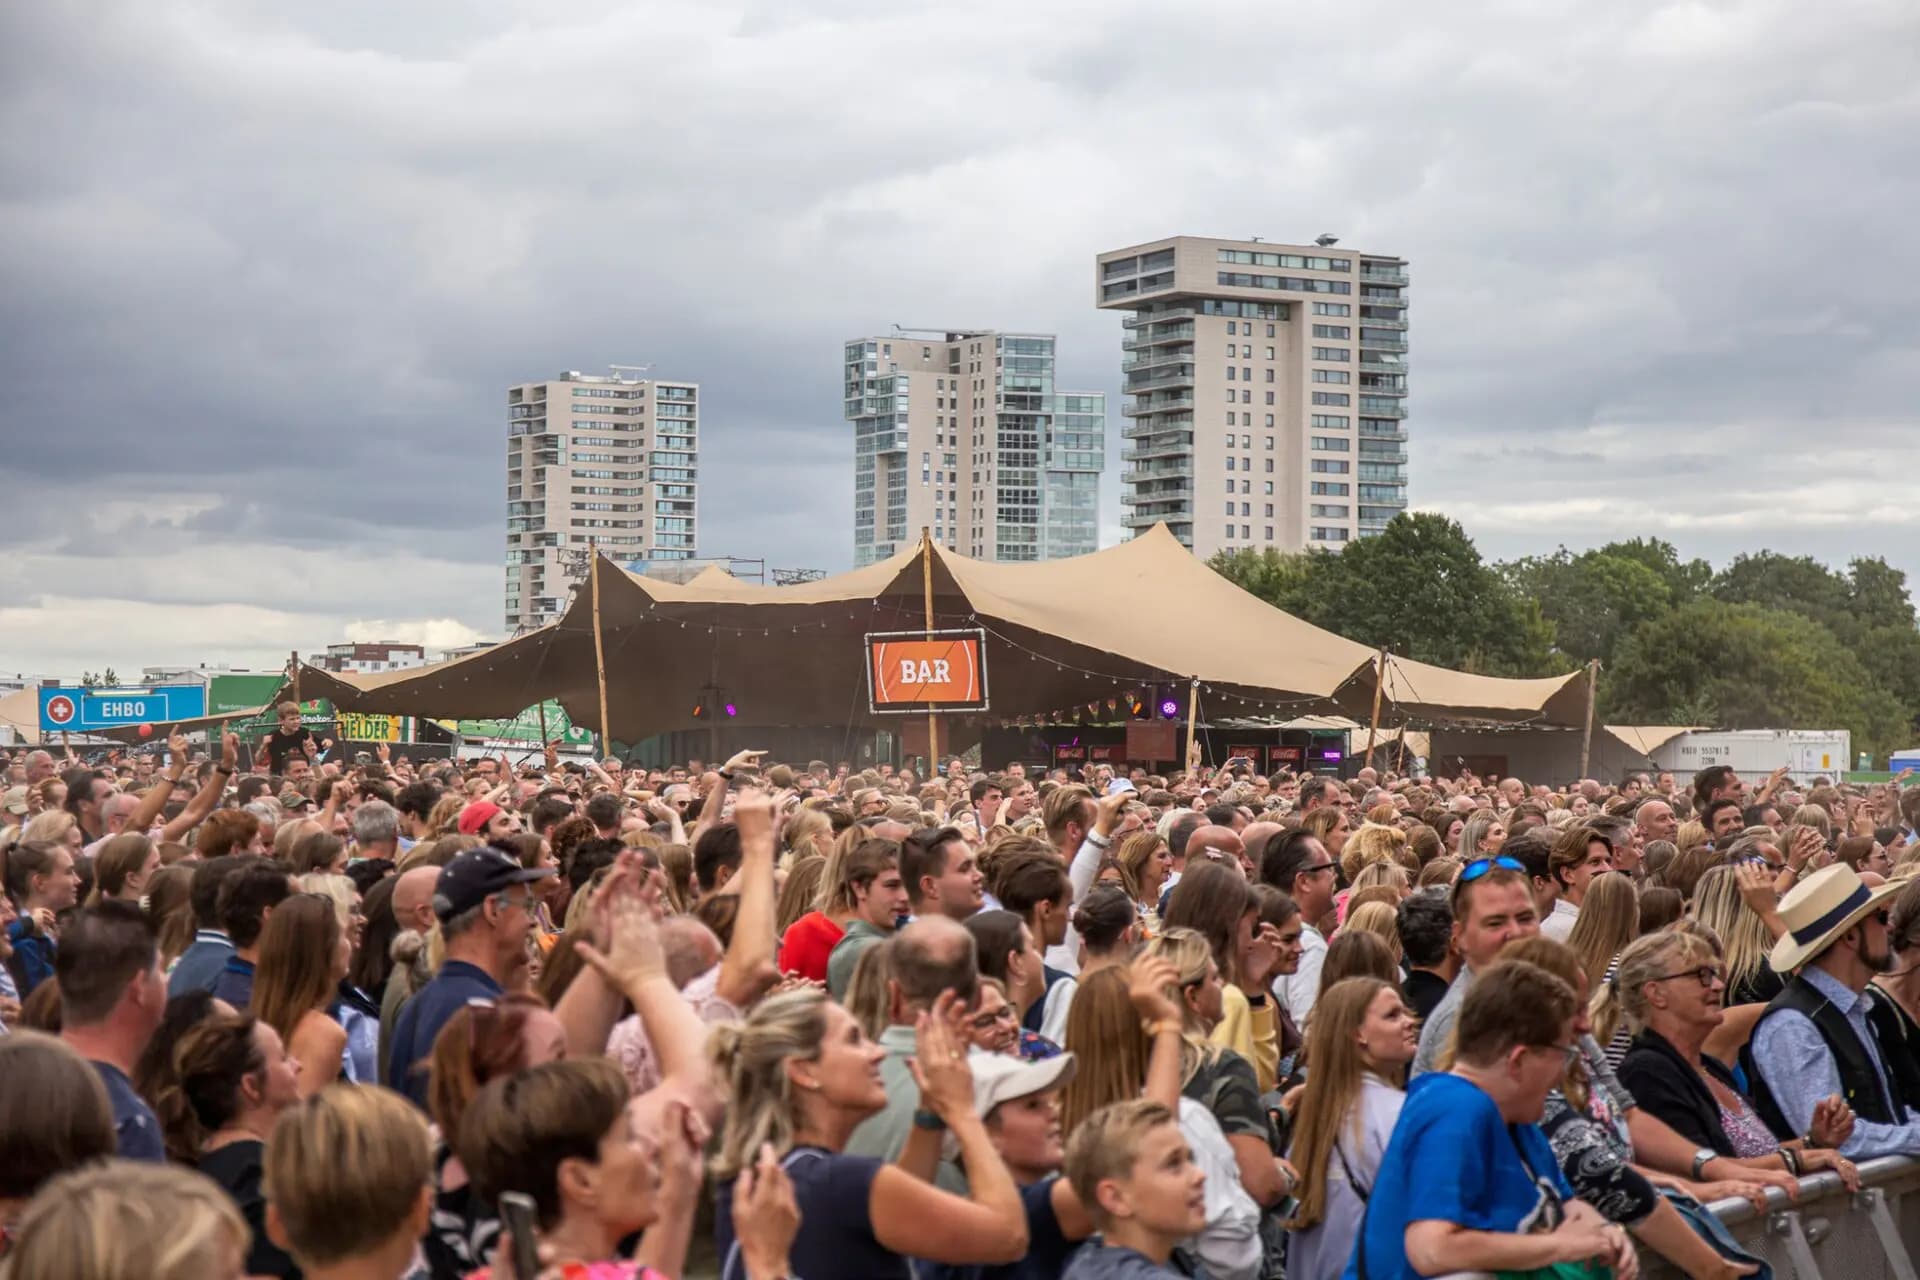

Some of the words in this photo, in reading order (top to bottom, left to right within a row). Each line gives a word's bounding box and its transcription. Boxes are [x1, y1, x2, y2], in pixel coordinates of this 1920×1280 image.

[900, 659, 952, 684] BAR
[102, 702, 145, 717] EHBO
[342, 719, 389, 739] HELDER
